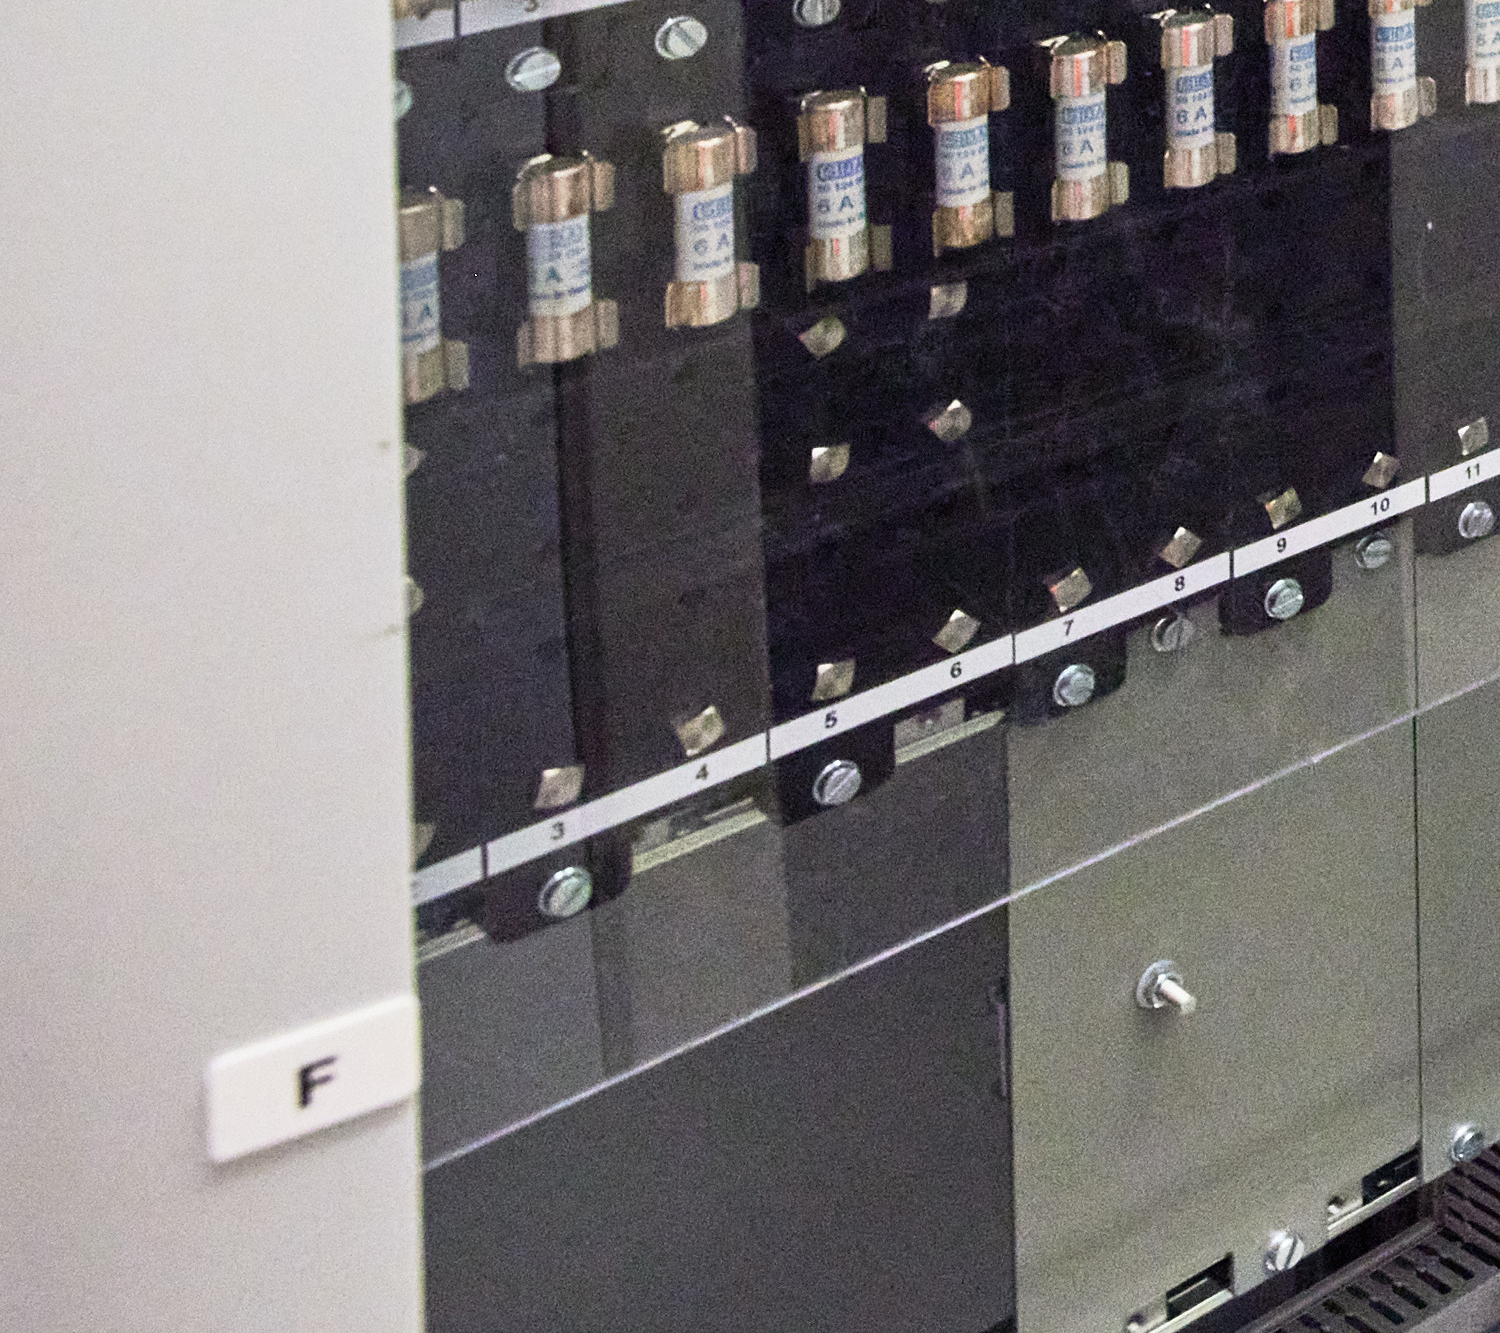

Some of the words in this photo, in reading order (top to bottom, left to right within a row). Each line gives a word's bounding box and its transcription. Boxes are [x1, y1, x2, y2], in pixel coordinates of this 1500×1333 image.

[551, 820, 565, 840] 3
[695, 763, 709, 781] 4
[825, 710, 837, 729] 5
[950, 660, 962, 679] 6
[1062, 619, 1074, 637] 7
[1174, 574, 1186, 592] 8
[1276, 536, 1287, 554] 9
[1370, 496, 1391, 516] 10
[1465, 462, 1480, 481] 11
[296, 1055, 338, 1110] F
